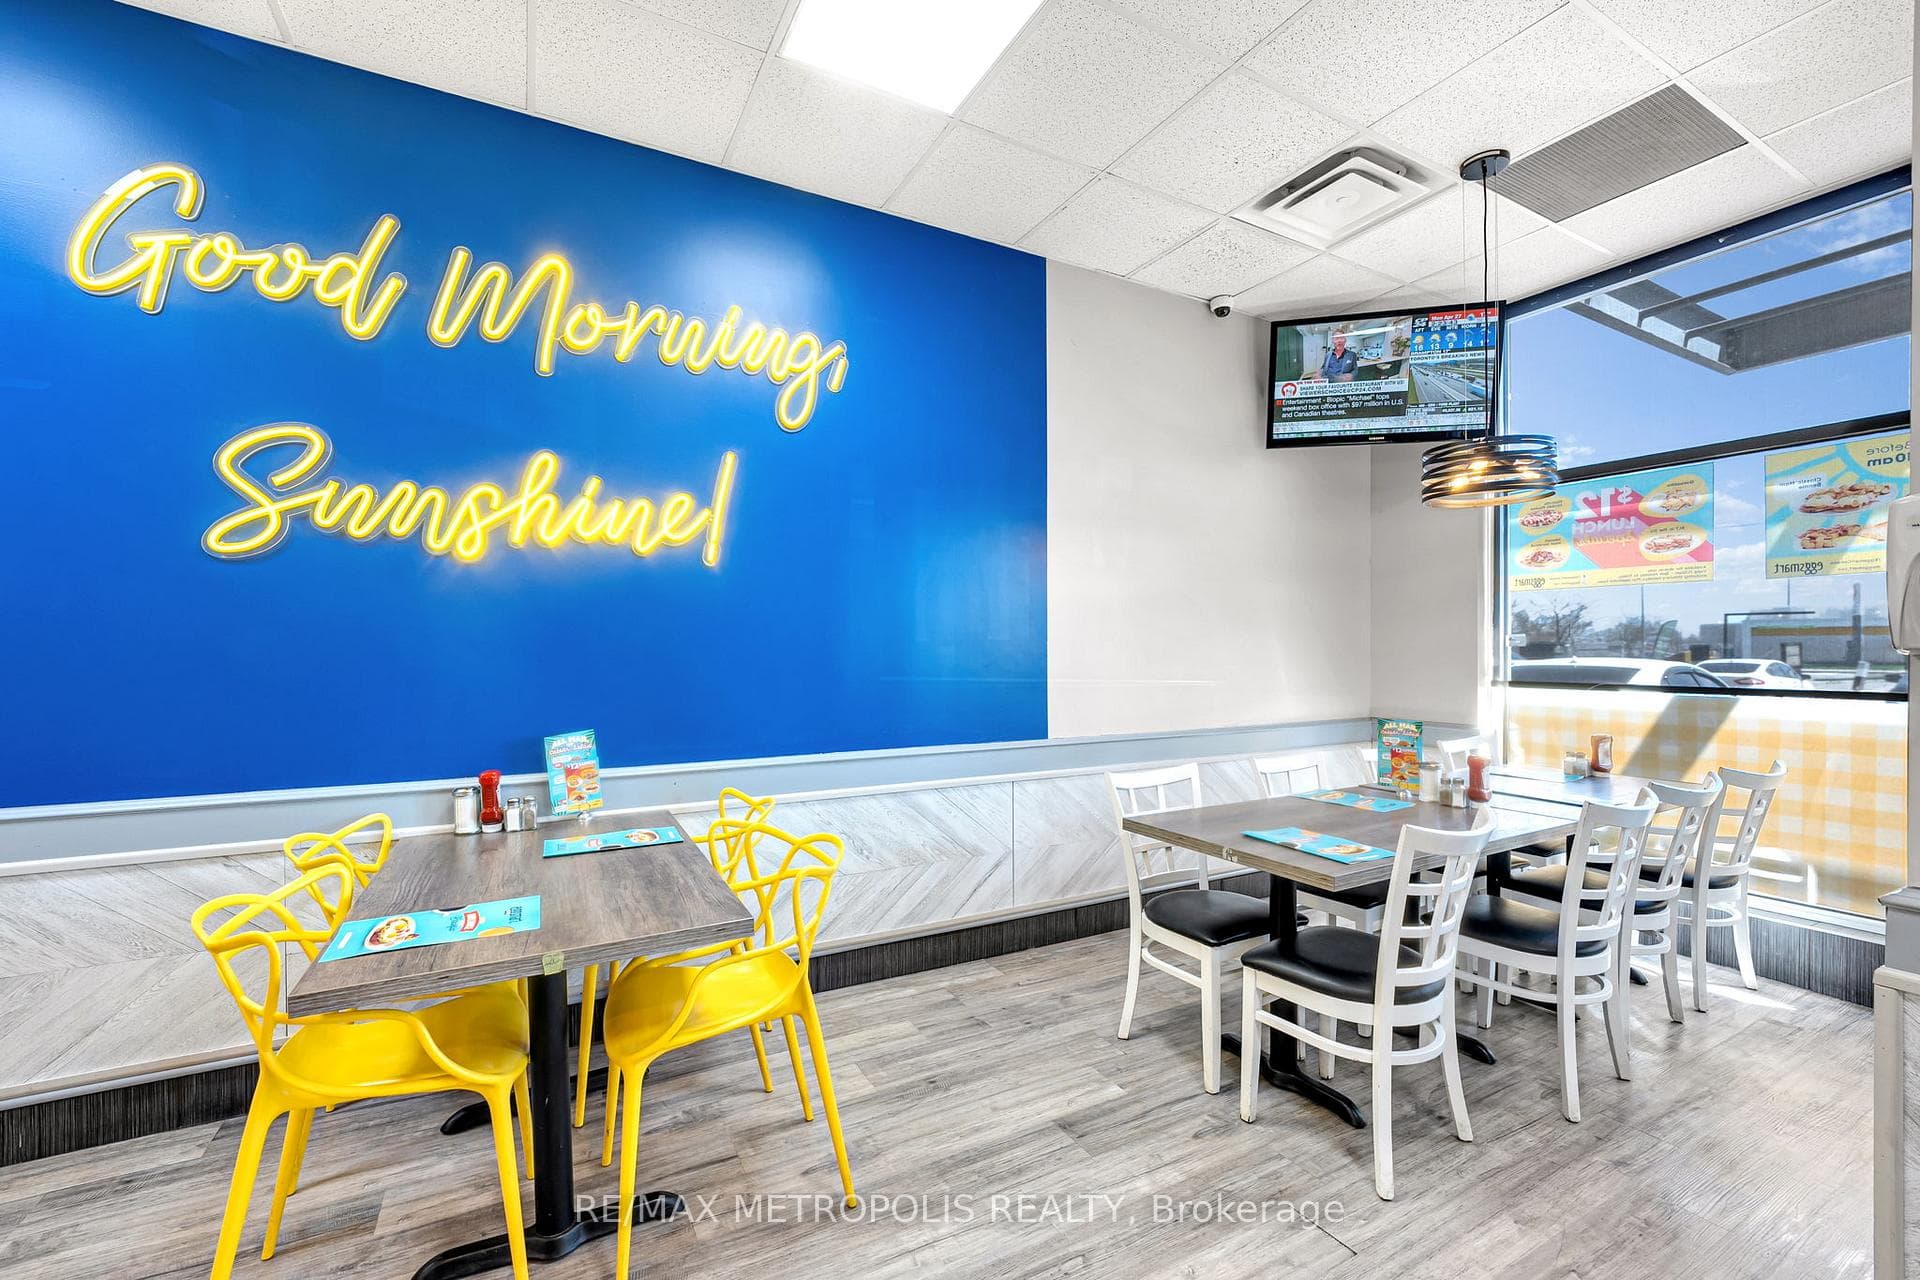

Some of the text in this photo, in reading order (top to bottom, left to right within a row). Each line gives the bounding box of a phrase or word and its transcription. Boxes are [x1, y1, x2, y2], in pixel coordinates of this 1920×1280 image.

[68, 165, 848, 431] Good Morning,
[1282, 397, 1321, 405] Entertainment
[1327, 396, 1345, 404] Biopic
[1376, 393, 1390, 401] tops
[1282, 403, 1308, 411] weekend
[1321, 401, 1337, 409] office
[1351, 400, 1363, 408] $97
[1364, 399, 1383, 407] million
[1282, 408, 1347, 418] and Canadian theatres.
[202, 422, 738, 566] Sunshine!
